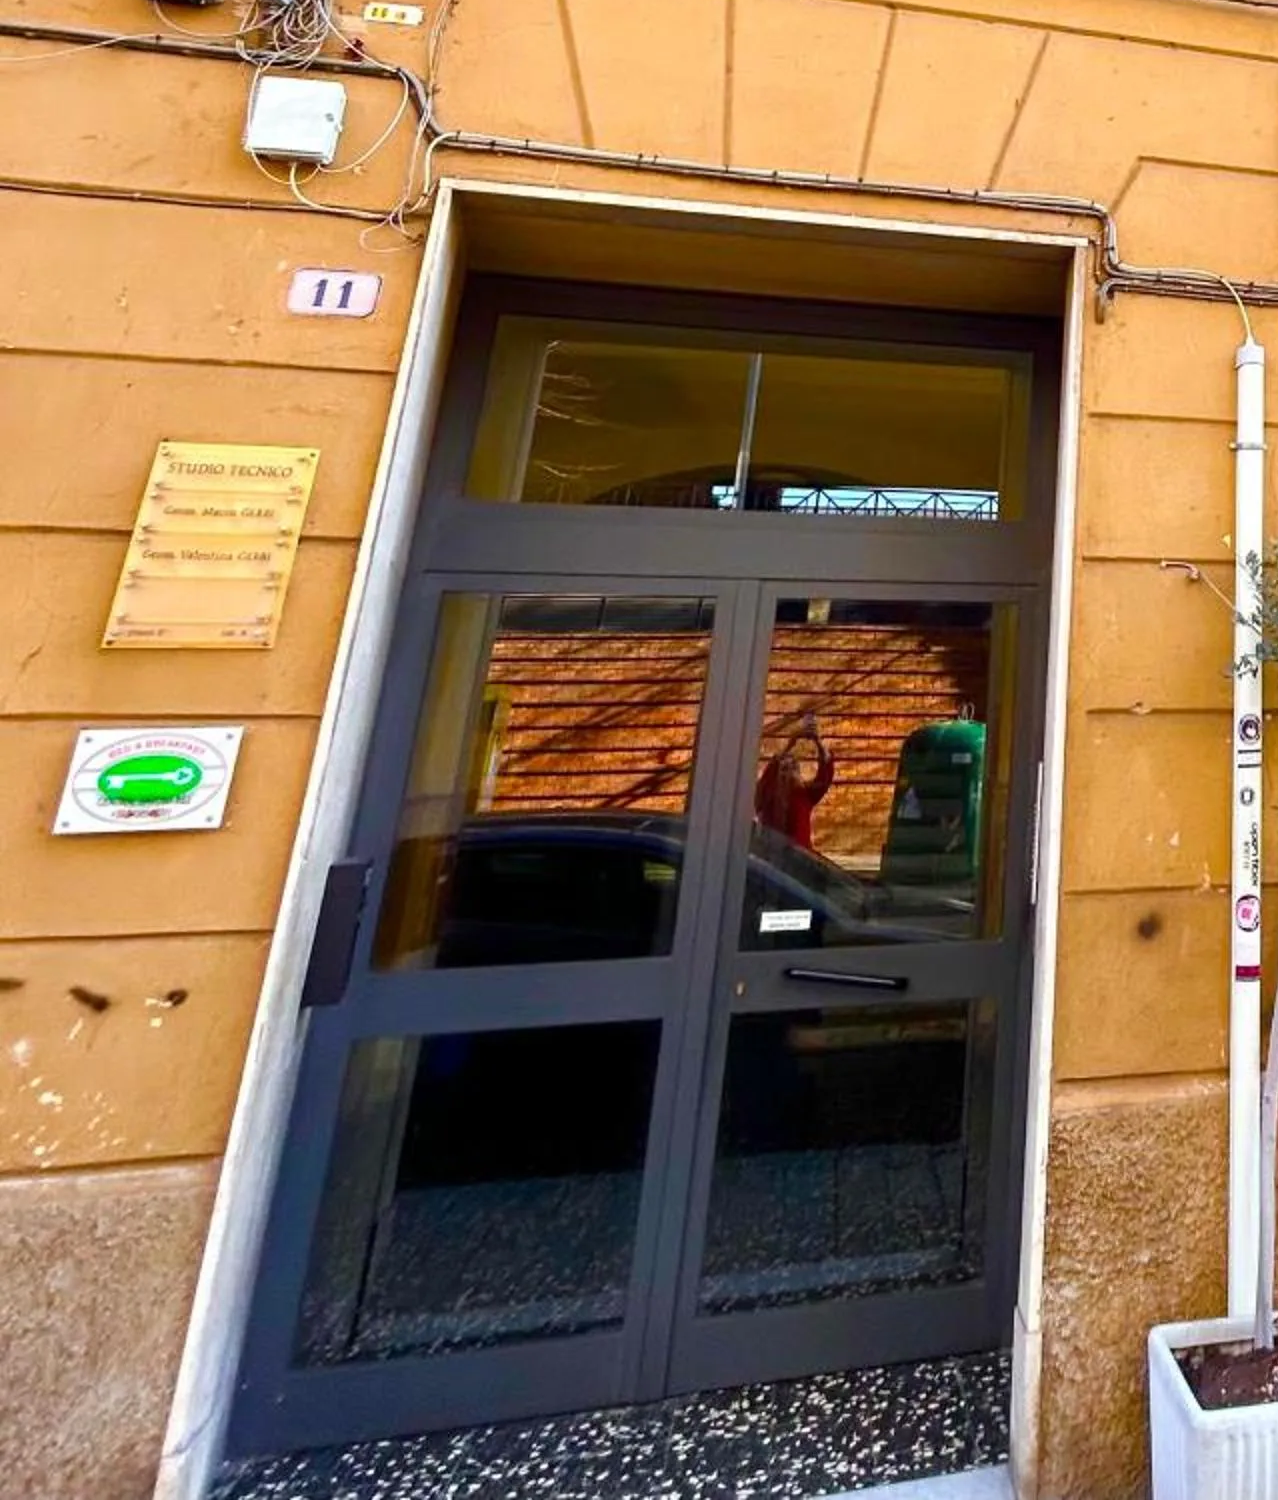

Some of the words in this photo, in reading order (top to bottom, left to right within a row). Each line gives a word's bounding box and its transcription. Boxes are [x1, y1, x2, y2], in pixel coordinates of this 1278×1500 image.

[311, 279, 354, 309] 11
[167, 462, 225, 475] STUDIO
[230, 464, 293, 479] TECNICO
